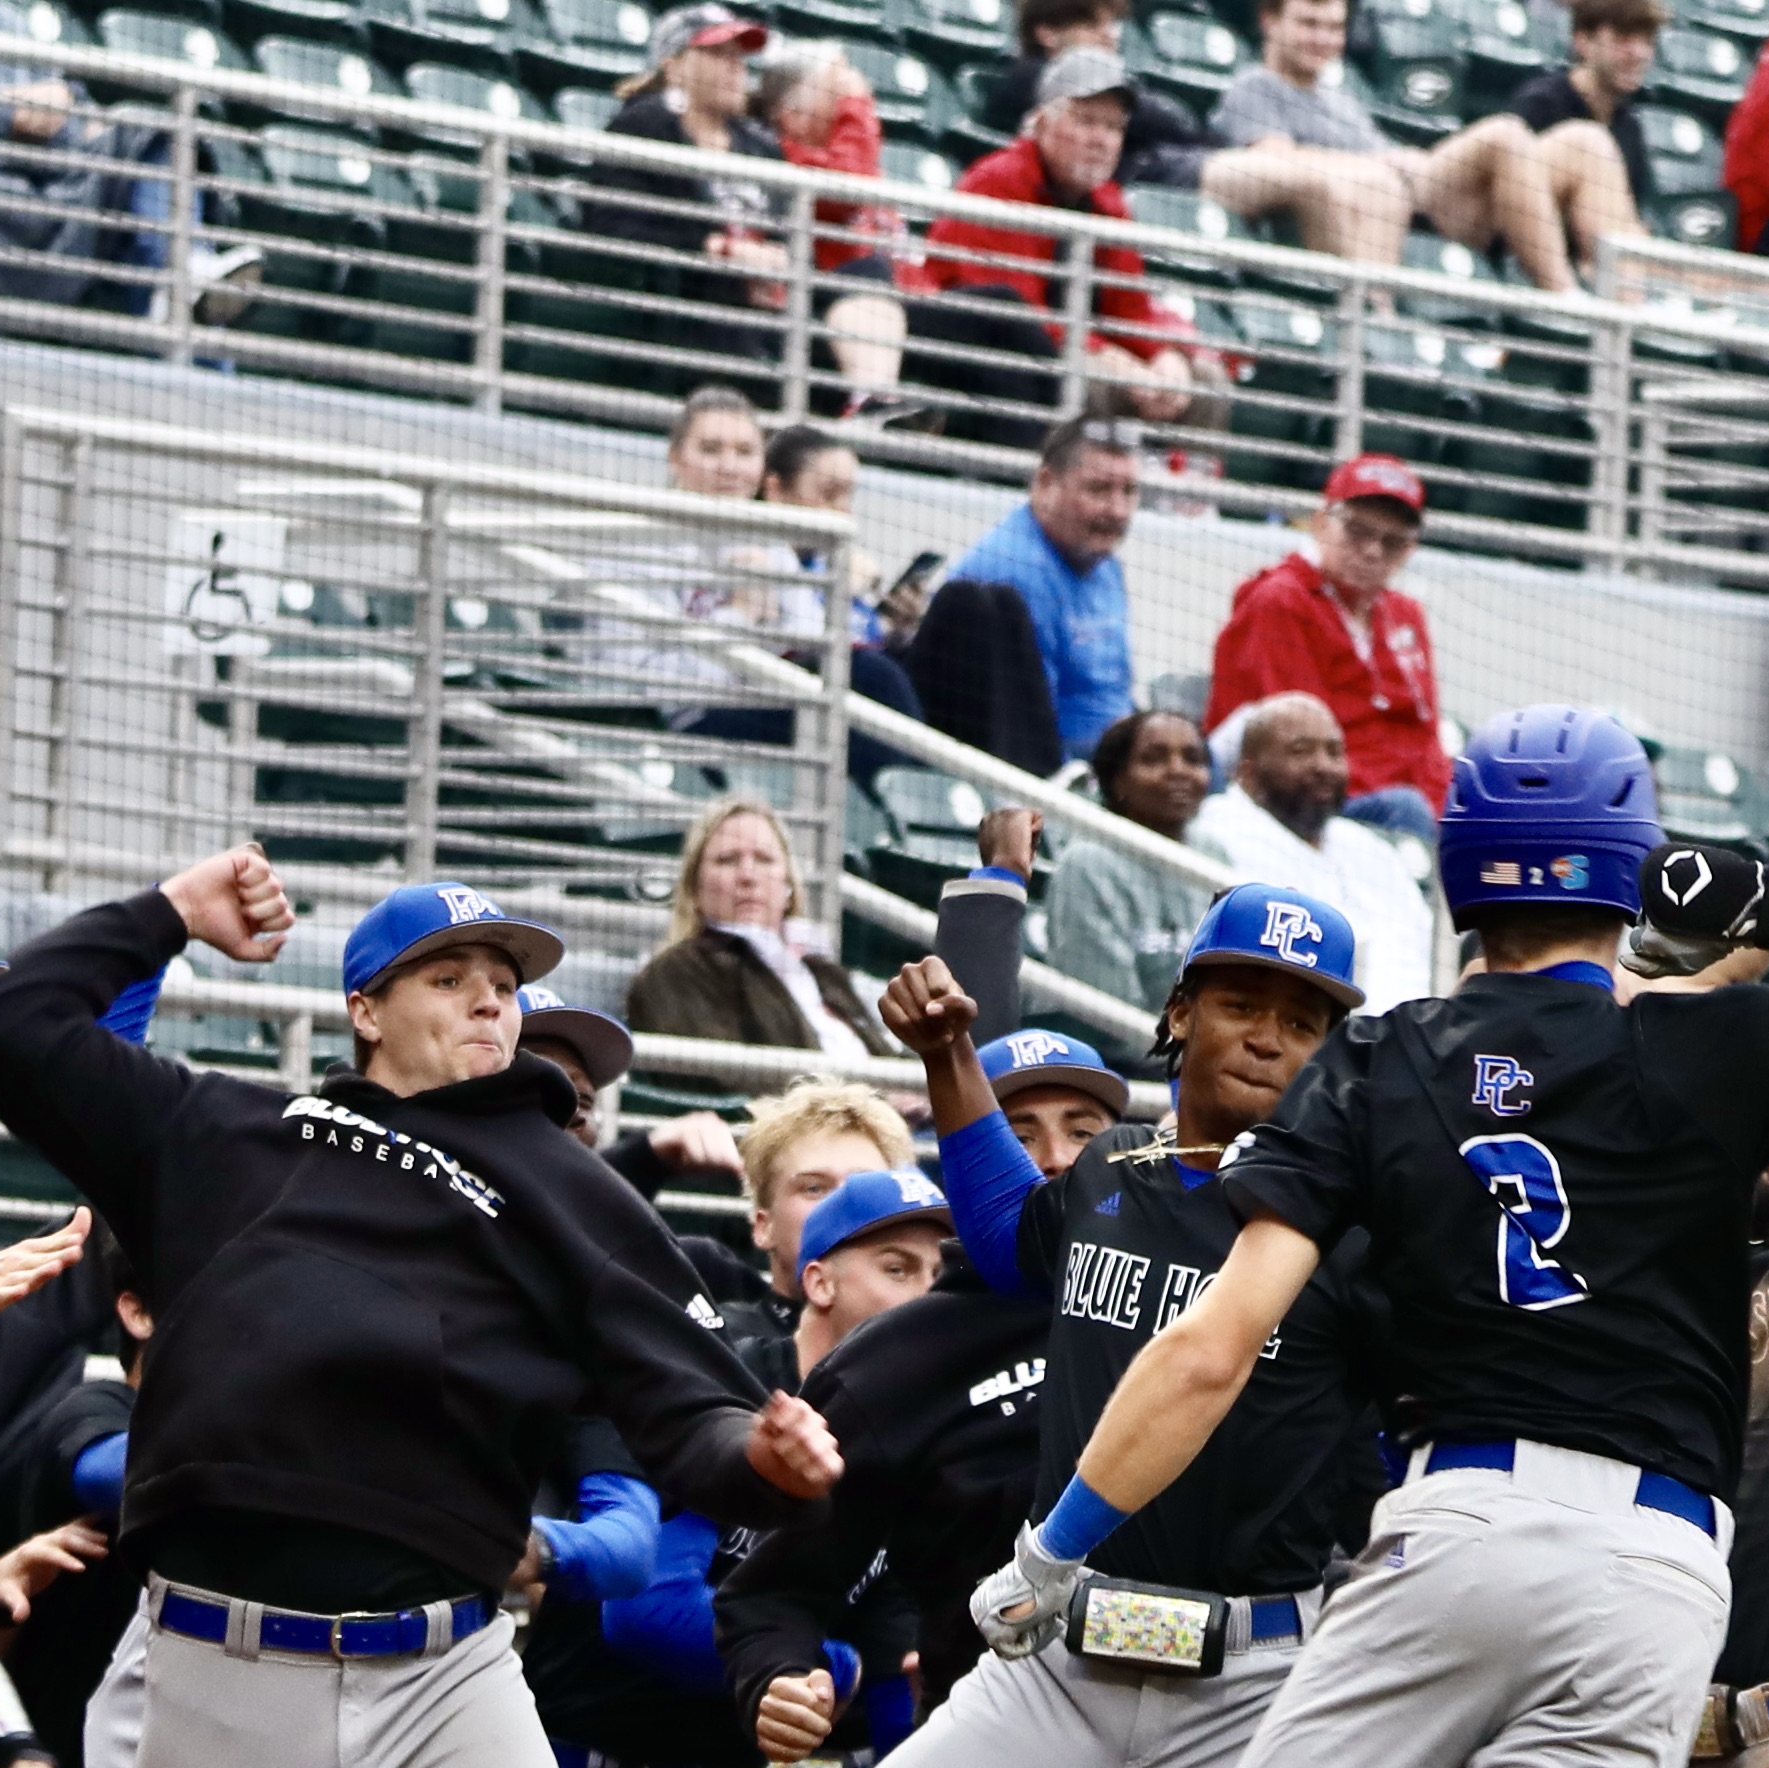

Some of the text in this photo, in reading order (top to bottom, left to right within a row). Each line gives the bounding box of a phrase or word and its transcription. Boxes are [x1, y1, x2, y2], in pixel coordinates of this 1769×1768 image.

[1260, 901, 1323, 968] PC
[1472, 1055, 1533, 1116] PC
[1458, 1132, 1592, 1311] 2
[1062, 1241, 1152, 1330] BLUE
